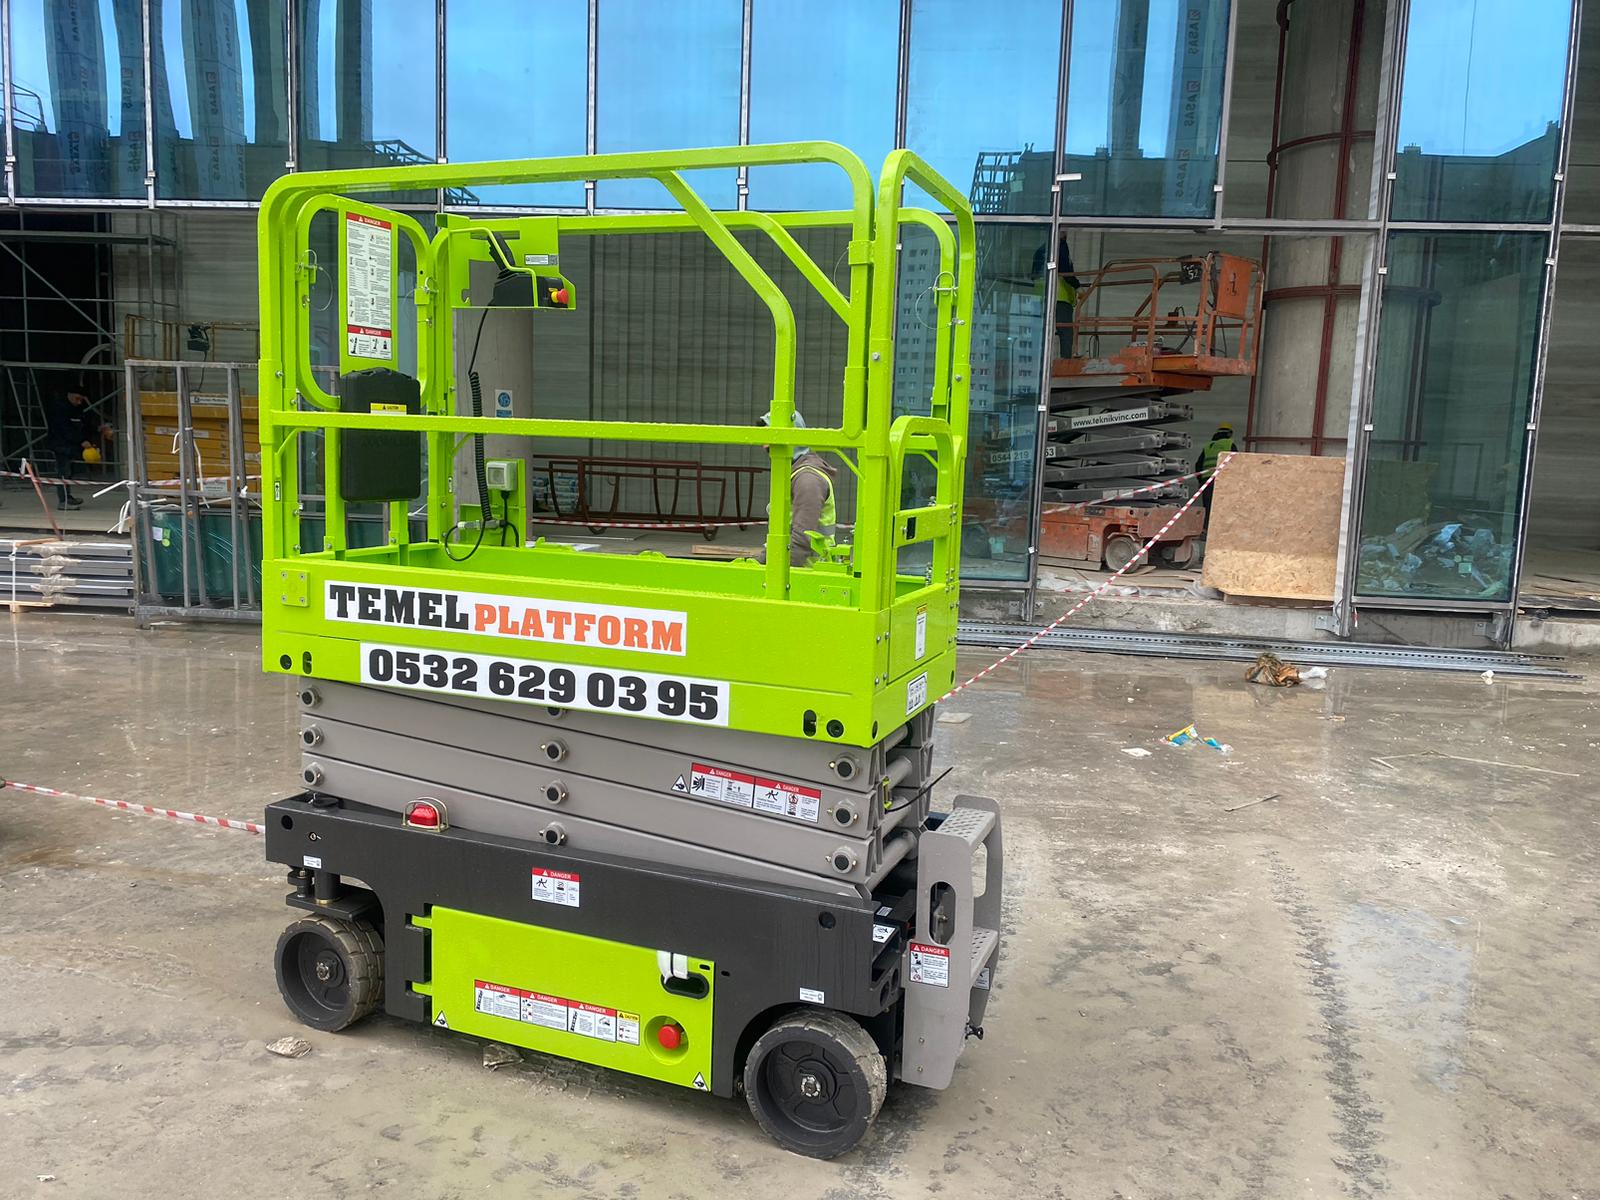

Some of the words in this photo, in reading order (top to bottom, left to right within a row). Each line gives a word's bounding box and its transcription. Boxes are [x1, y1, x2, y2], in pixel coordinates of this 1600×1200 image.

[1073, 412, 1147, 427] www.teknikvinc.com
[329, 584, 469, 630] TEMEL
[474, 603, 683, 652] PLATFORM
[369, 648, 478, 692] 0532
[488, 661, 576, 703] 629
[587, 672, 647, 711] 03
[657, 680, 719, 721] 95
[550, 871, 571, 879] DANGER
[921, 946, 945, 954] DANGER
[490, 984, 510, 992] DANGER
[537, 994, 558, 1003] DANGER
[585, 1005, 606, 1013] DANGER
